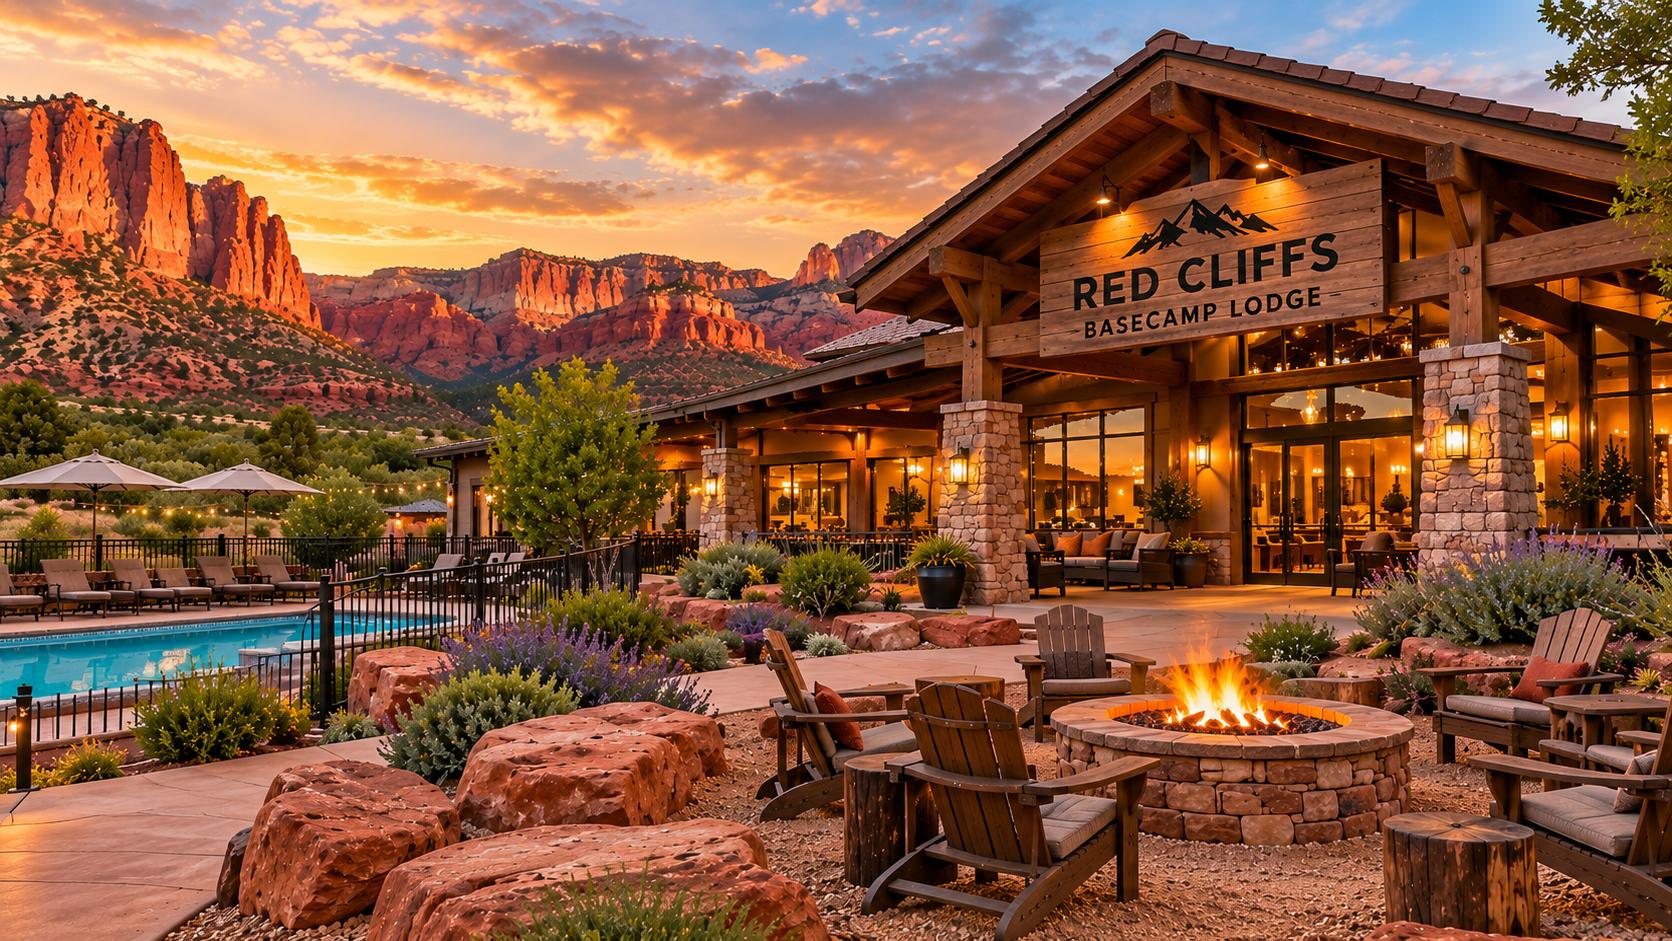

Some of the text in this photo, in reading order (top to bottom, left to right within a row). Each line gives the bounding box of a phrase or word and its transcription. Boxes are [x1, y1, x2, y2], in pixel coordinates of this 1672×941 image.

[1073, 232, 1339, 311] RED CLIFFS
[1084, 286, 1322, 339] BASECAMP LODGE
